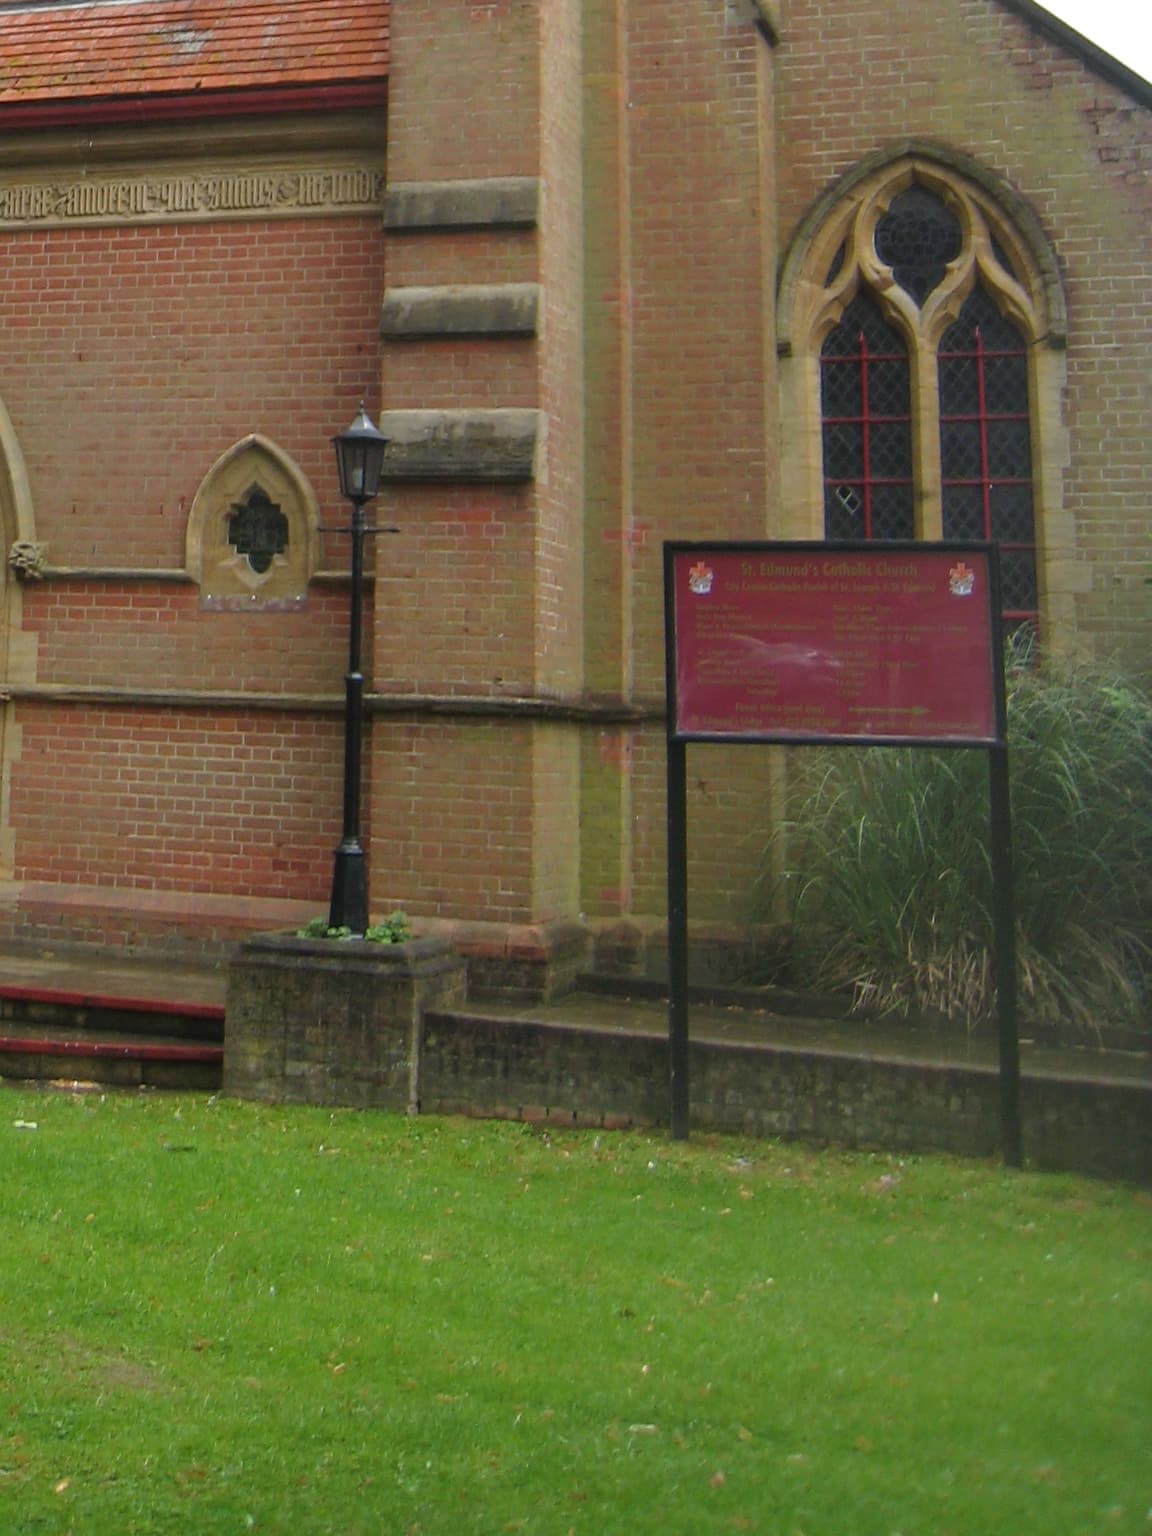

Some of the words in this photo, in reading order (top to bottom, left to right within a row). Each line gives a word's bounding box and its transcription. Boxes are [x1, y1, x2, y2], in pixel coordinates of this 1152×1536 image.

[759, 560, 819, 577] Edmund's
[822, 560, 873, 578] Catholic
[876, 561, 919, 578] Church
